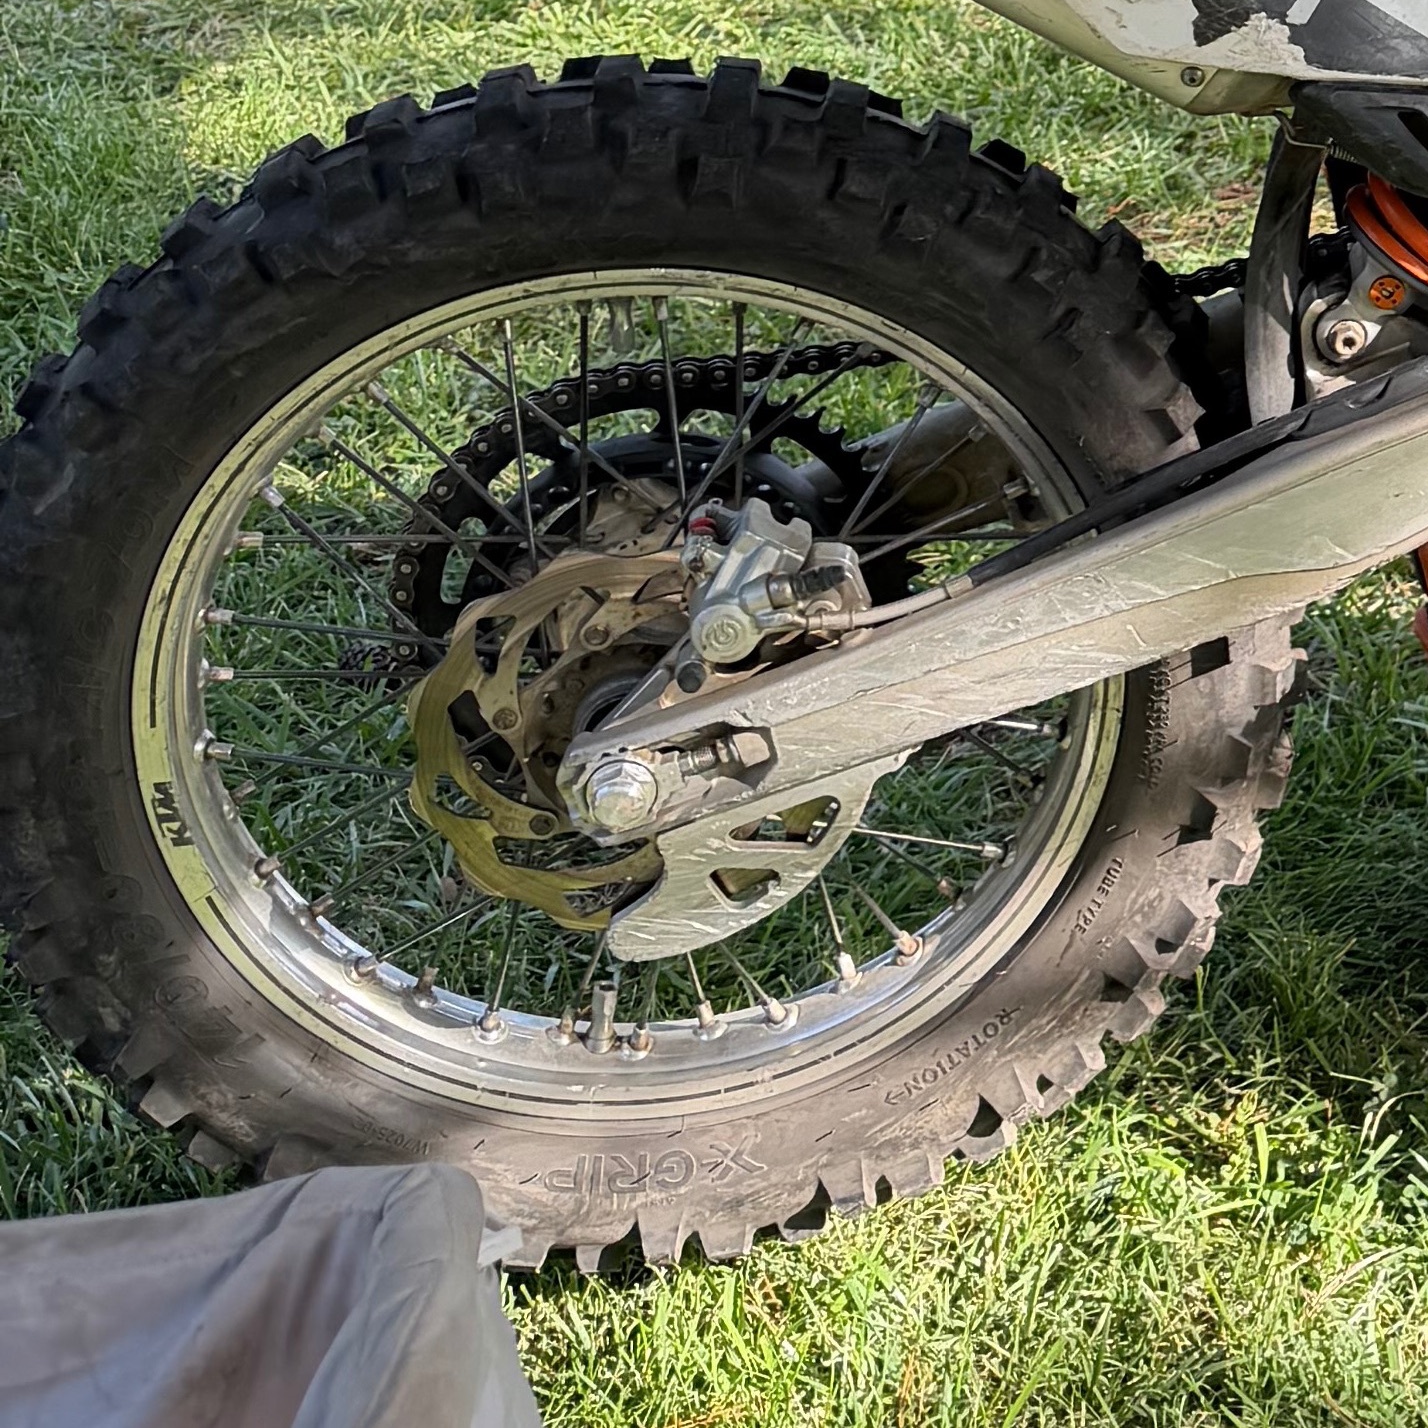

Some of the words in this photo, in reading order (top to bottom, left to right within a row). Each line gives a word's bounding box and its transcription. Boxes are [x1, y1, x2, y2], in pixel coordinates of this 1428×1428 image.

[151, 780, 196, 847] KTM
[1096, 857, 1125, 898] TUBE
[1074, 900, 1103, 935] TYPE
[902, 1008, 1016, 1096] ROTATION
[543, 1133, 768, 1194] X-GRIP
